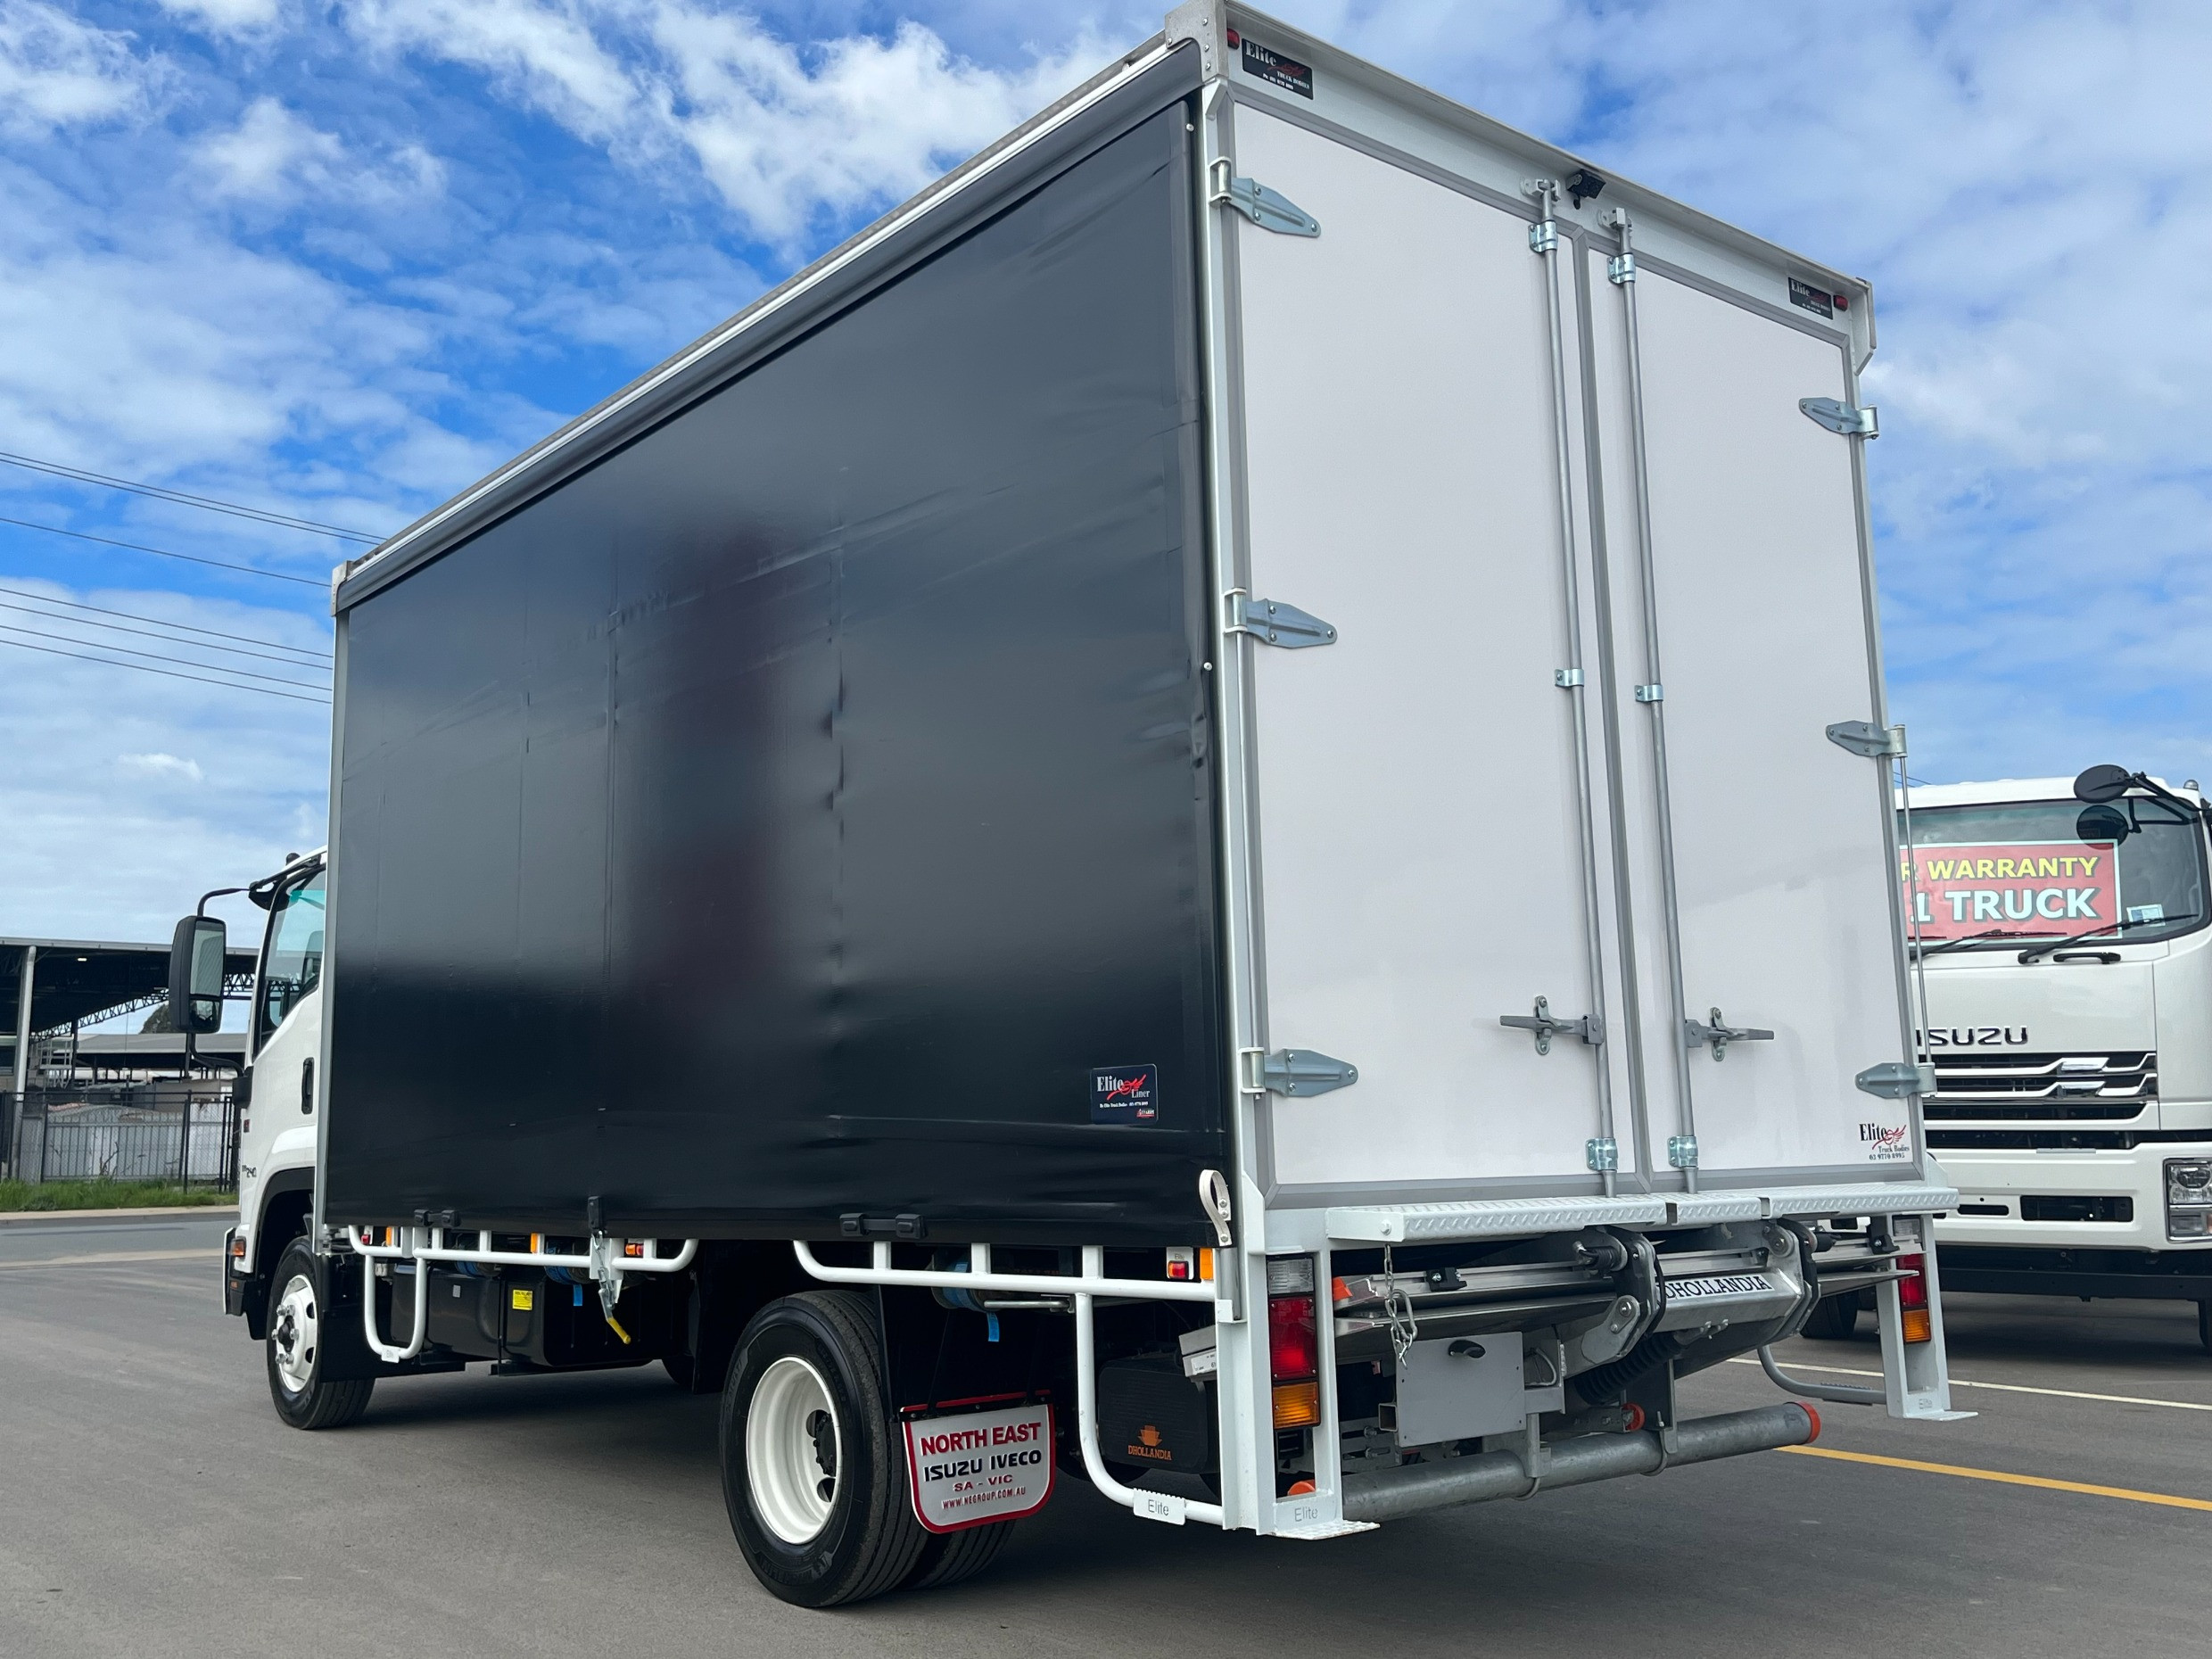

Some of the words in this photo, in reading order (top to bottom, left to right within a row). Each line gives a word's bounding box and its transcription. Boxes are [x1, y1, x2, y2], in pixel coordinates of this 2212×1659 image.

[1245, 41, 1277, 66] Elite
[1791, 279, 1811, 296] Elite
[1927, 857, 2098, 880] WARRANTY
[1945, 887, 2096, 922] TRUCK
[1915, 1026, 2028, 1046] ISUZU
[1096, 1075, 1125, 1092] Elite
[1131, 1088, 1151, 1098] Liner
[1859, 1122, 1888, 1141] Elite
[1878, 1145, 1893, 1153] Truck
[1894, 1144, 1910, 1152] Bodies
[1659, 1275, 1772, 1299] DHOLLANDIA
[920, 1429, 987, 1457] NORTH
[992, 1422, 1042, 1446] EAST
[1127, 1444, 1172, 1461] DHOLLANDIA
[924, 1457, 983, 1482] ISUZU
[991, 1449, 1042, 1470] IVECO
[953, 1482, 974, 1492] SA
[987, 1474, 1013, 1486] VIC
[942, 1487, 1027, 1509] WWW.NEGROUP.COM.AU
[1148, 1498, 1169, 1516] Elite
[1294, 1506, 1319, 1523] Elite
